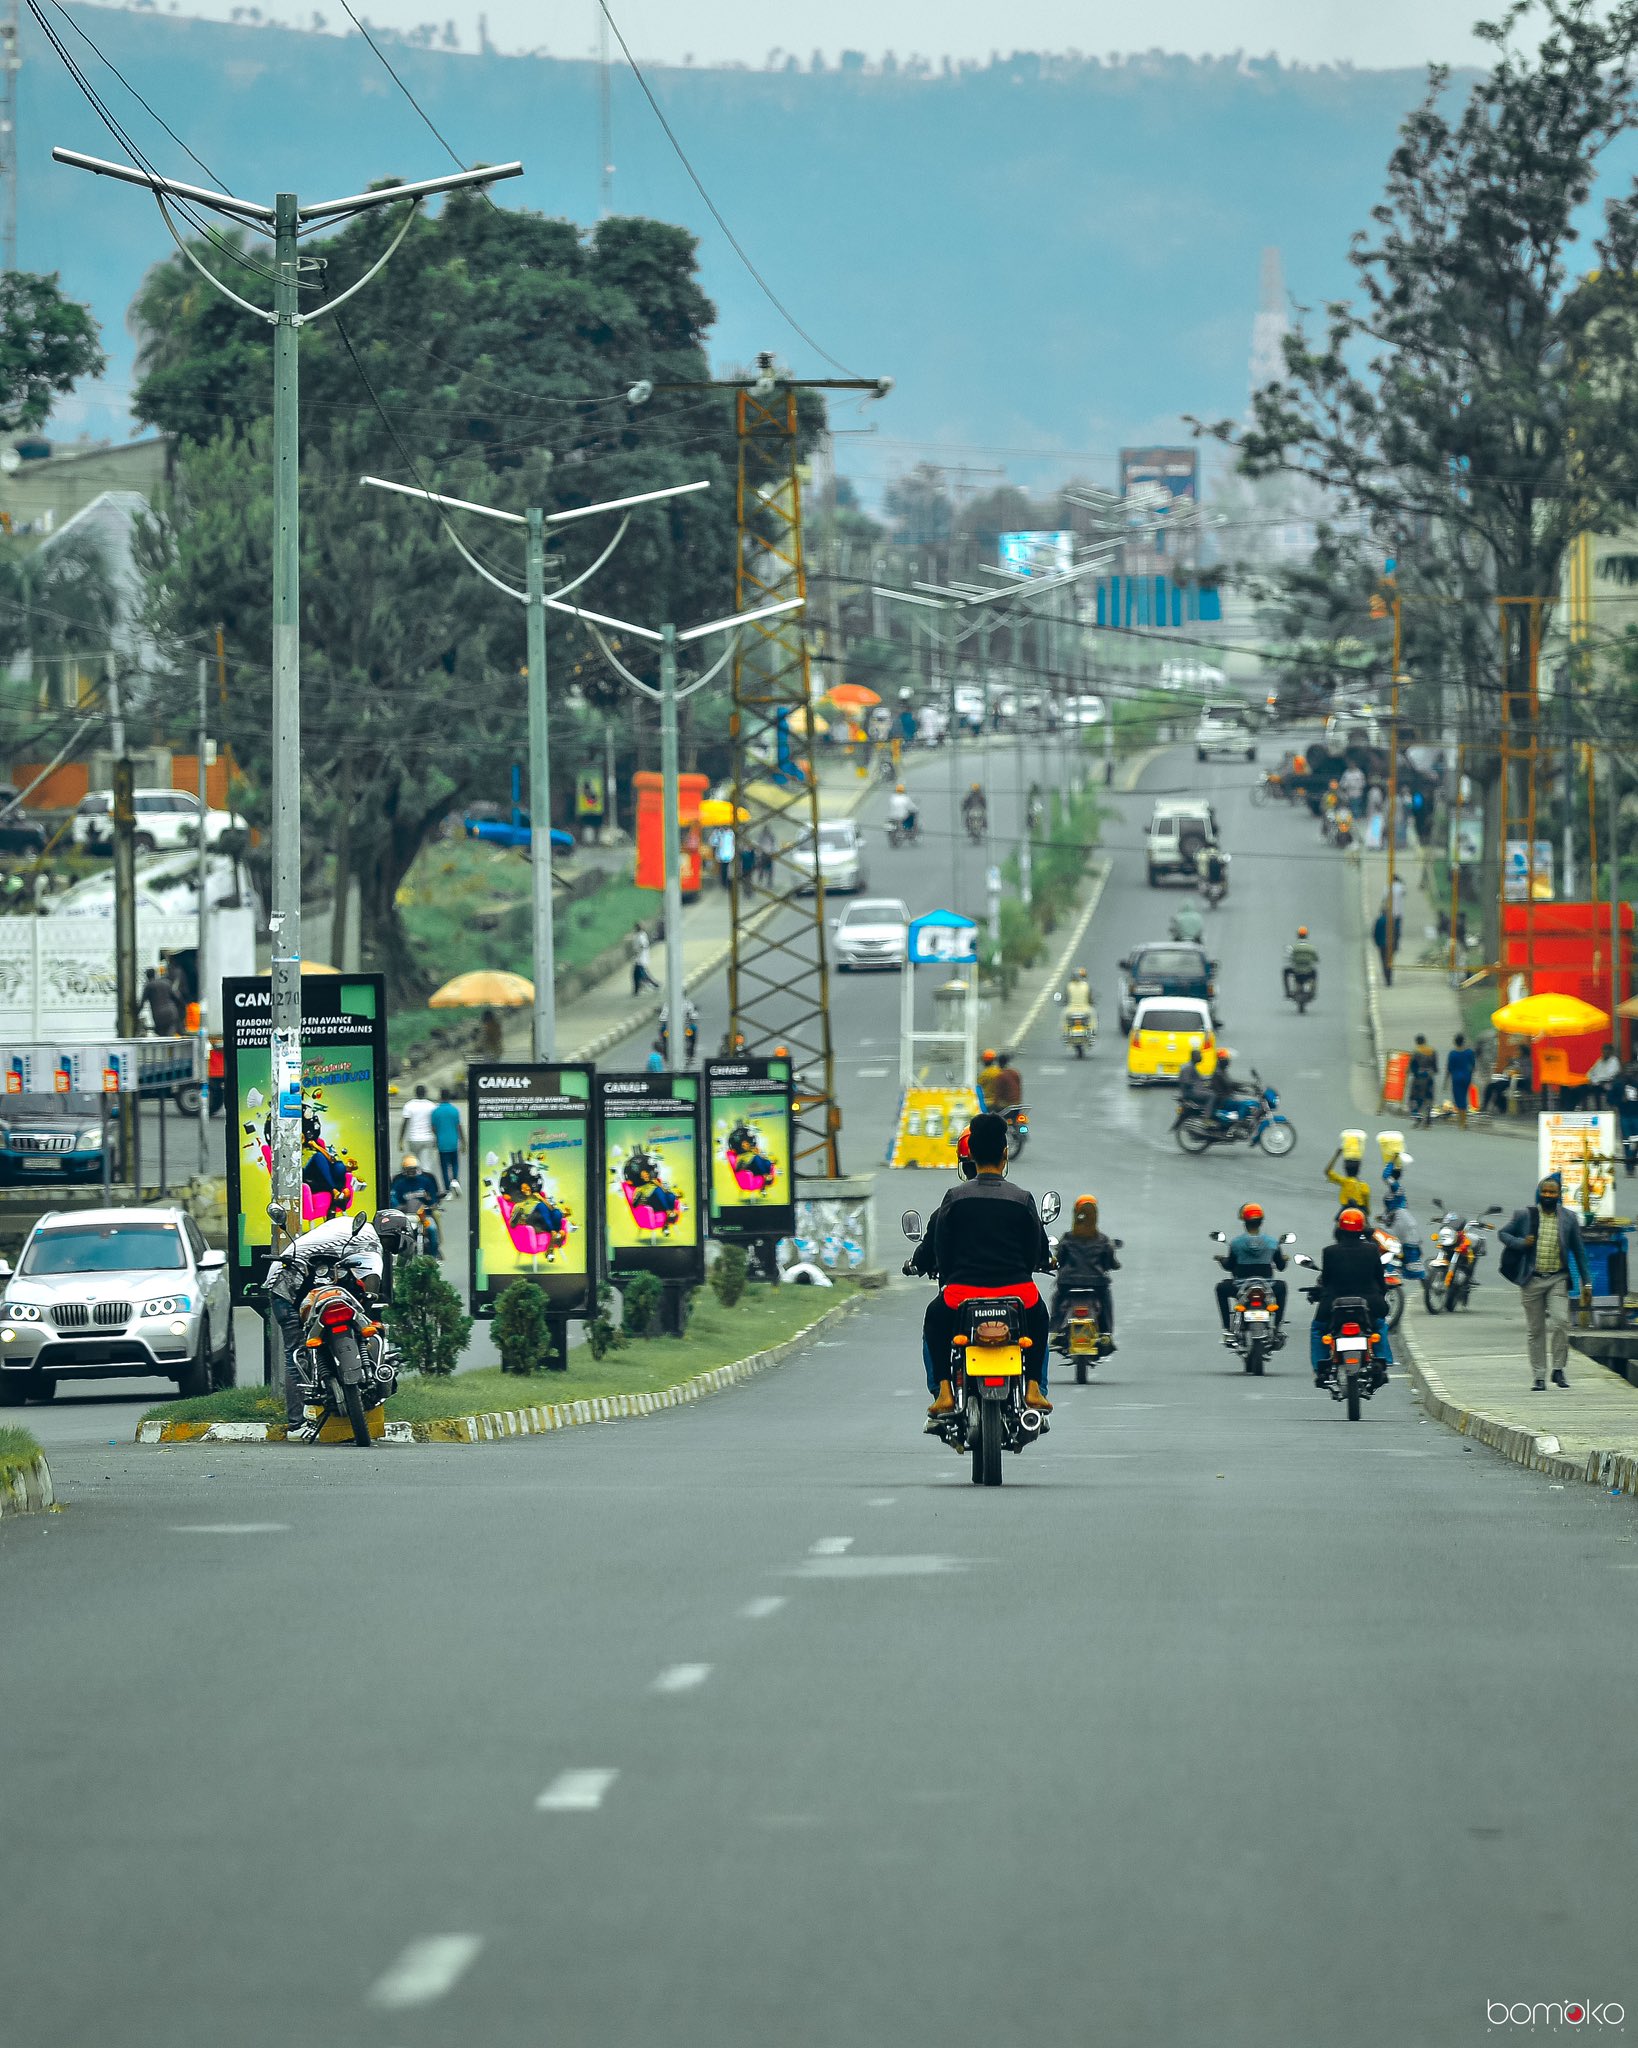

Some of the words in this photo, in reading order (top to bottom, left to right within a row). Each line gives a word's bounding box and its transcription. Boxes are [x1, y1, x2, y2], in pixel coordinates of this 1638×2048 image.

[278, 969, 288, 984] S
[234, 992, 272, 1008] CAN
[307, 1017, 319, 1026] EN
[319, 1016, 353, 1025] AVANCE
[246, 1027, 272, 1036] PROFIT
[327, 1025, 337, 1034] DE
[338, 1025, 373, 1034] CHAINES
[236, 1037, 248, 1046] EN
[248, 1036, 268, 1046] PLUS
[478, 1076, 532, 1089] CANAL+
